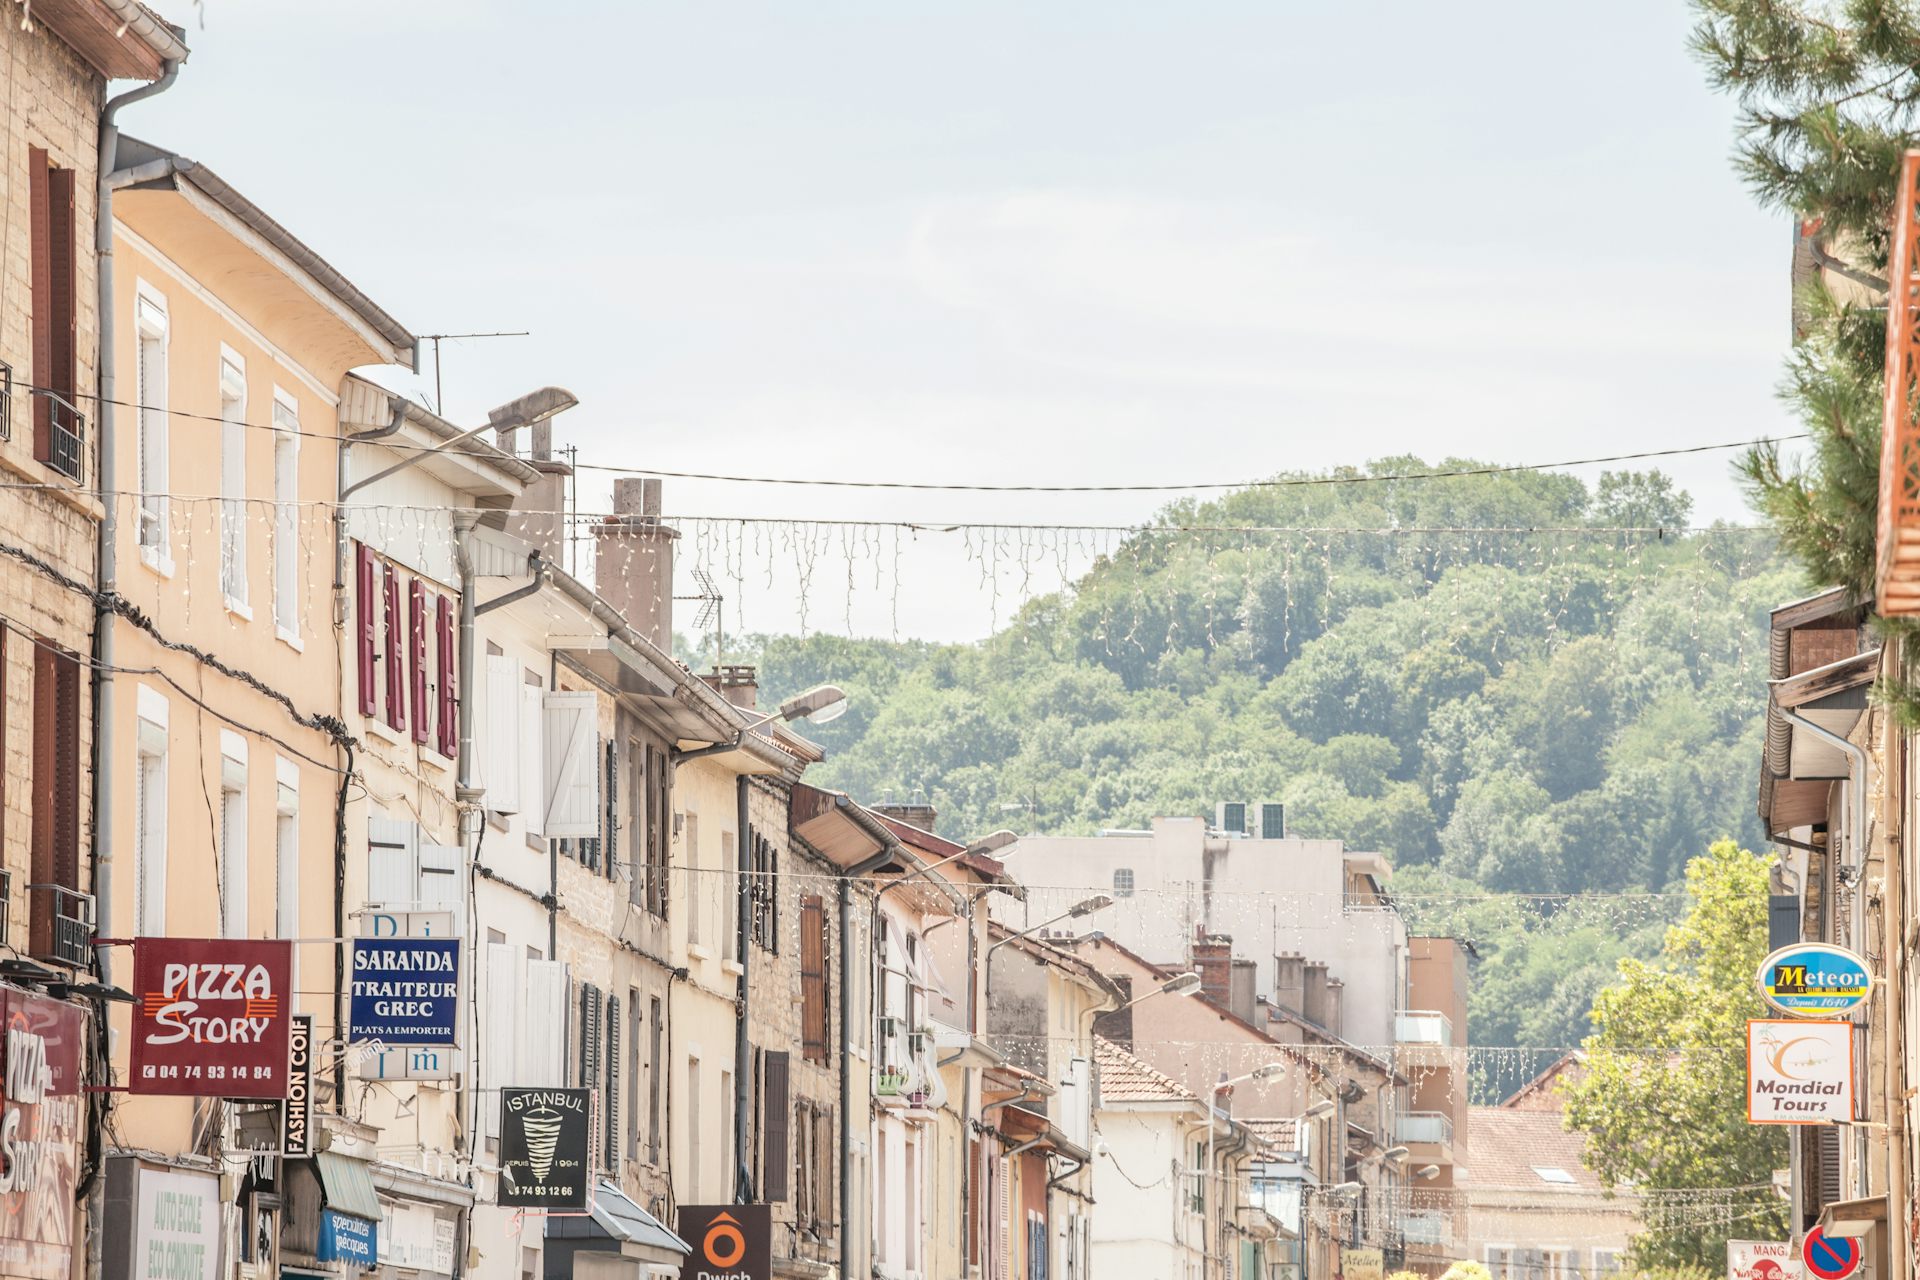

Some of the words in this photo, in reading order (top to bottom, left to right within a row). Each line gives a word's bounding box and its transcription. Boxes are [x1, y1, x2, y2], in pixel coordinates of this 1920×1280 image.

[354, 950, 454, 972] SARANDA
[163, 964, 271, 1000] PIZZA
[1776, 967, 1864, 986] Meteor
[352, 981, 457, 998] TRAITEUR
[374, 1001, 433, 1017] GREC
[1821, 997, 1848, 1007] 1640
[352, 1026, 384, 1035] PLATS
[385, 1026, 393, 1035] A
[394, 1026, 451, 1036] EMPORTER
[291, 1020, 307, 1066] COIF
[6, 1029, 46, 1105] PIZZA
[160, 1066, 178, 1078] 04
[185, 1066, 200, 1078] 74
[207, 1066, 225, 1079] 93
[232, 1066, 247, 1079] 14
[254, 1066, 271, 1079] 84
[1756, 1080, 1843, 1095] Mondial
[507, 1092, 584, 1113] ISTANBUL
[1772, 1097, 1828, 1111] Tours
[288, 1072, 306, 1152] FASHION
[522, 1186, 533, 1196] 74
[535, 1186, 546, 1196] 93
[549, 1186, 560, 1196] 12
[561, 1186, 573, 1196] 66
[154, 1192, 177, 1231] AUTO
[177, 1193, 202, 1233] ECOLE
[1753, 1245, 1788, 1256] MANG
